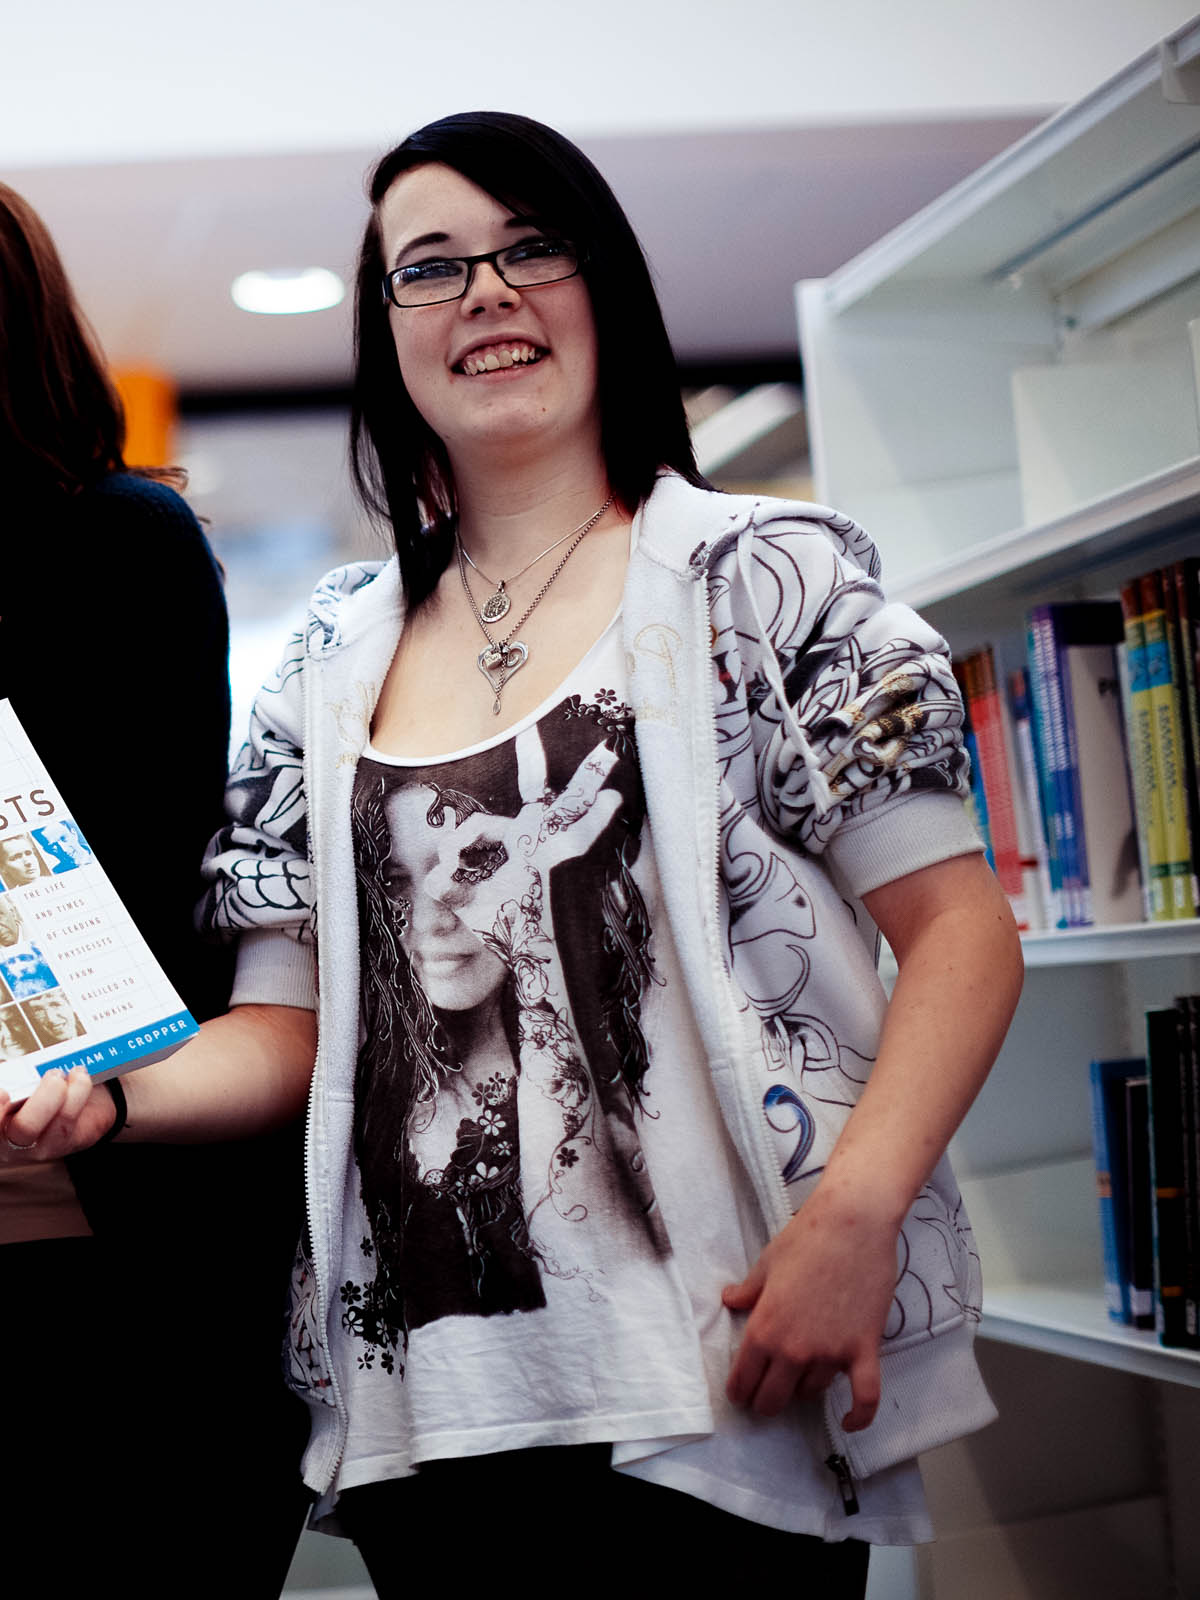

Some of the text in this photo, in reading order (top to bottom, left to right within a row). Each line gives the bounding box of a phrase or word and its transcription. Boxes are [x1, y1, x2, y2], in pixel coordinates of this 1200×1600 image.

[23, 881, 65, 900] THE LIFE
[35, 899, 85, 920] AND TIMES
[46, 917, 101, 940] OF LEADING
[58, 937, 112, 960] PHYSICISTS
[70, 967, 94, 981] FROM
[81, 977, 135, 1000] GALILEO TO
[93, 1002, 134, 1021] HAWKING
[54, 1052, 105, 1073] ILLIAM
[127, 1019, 187, 1049] CROPPER
